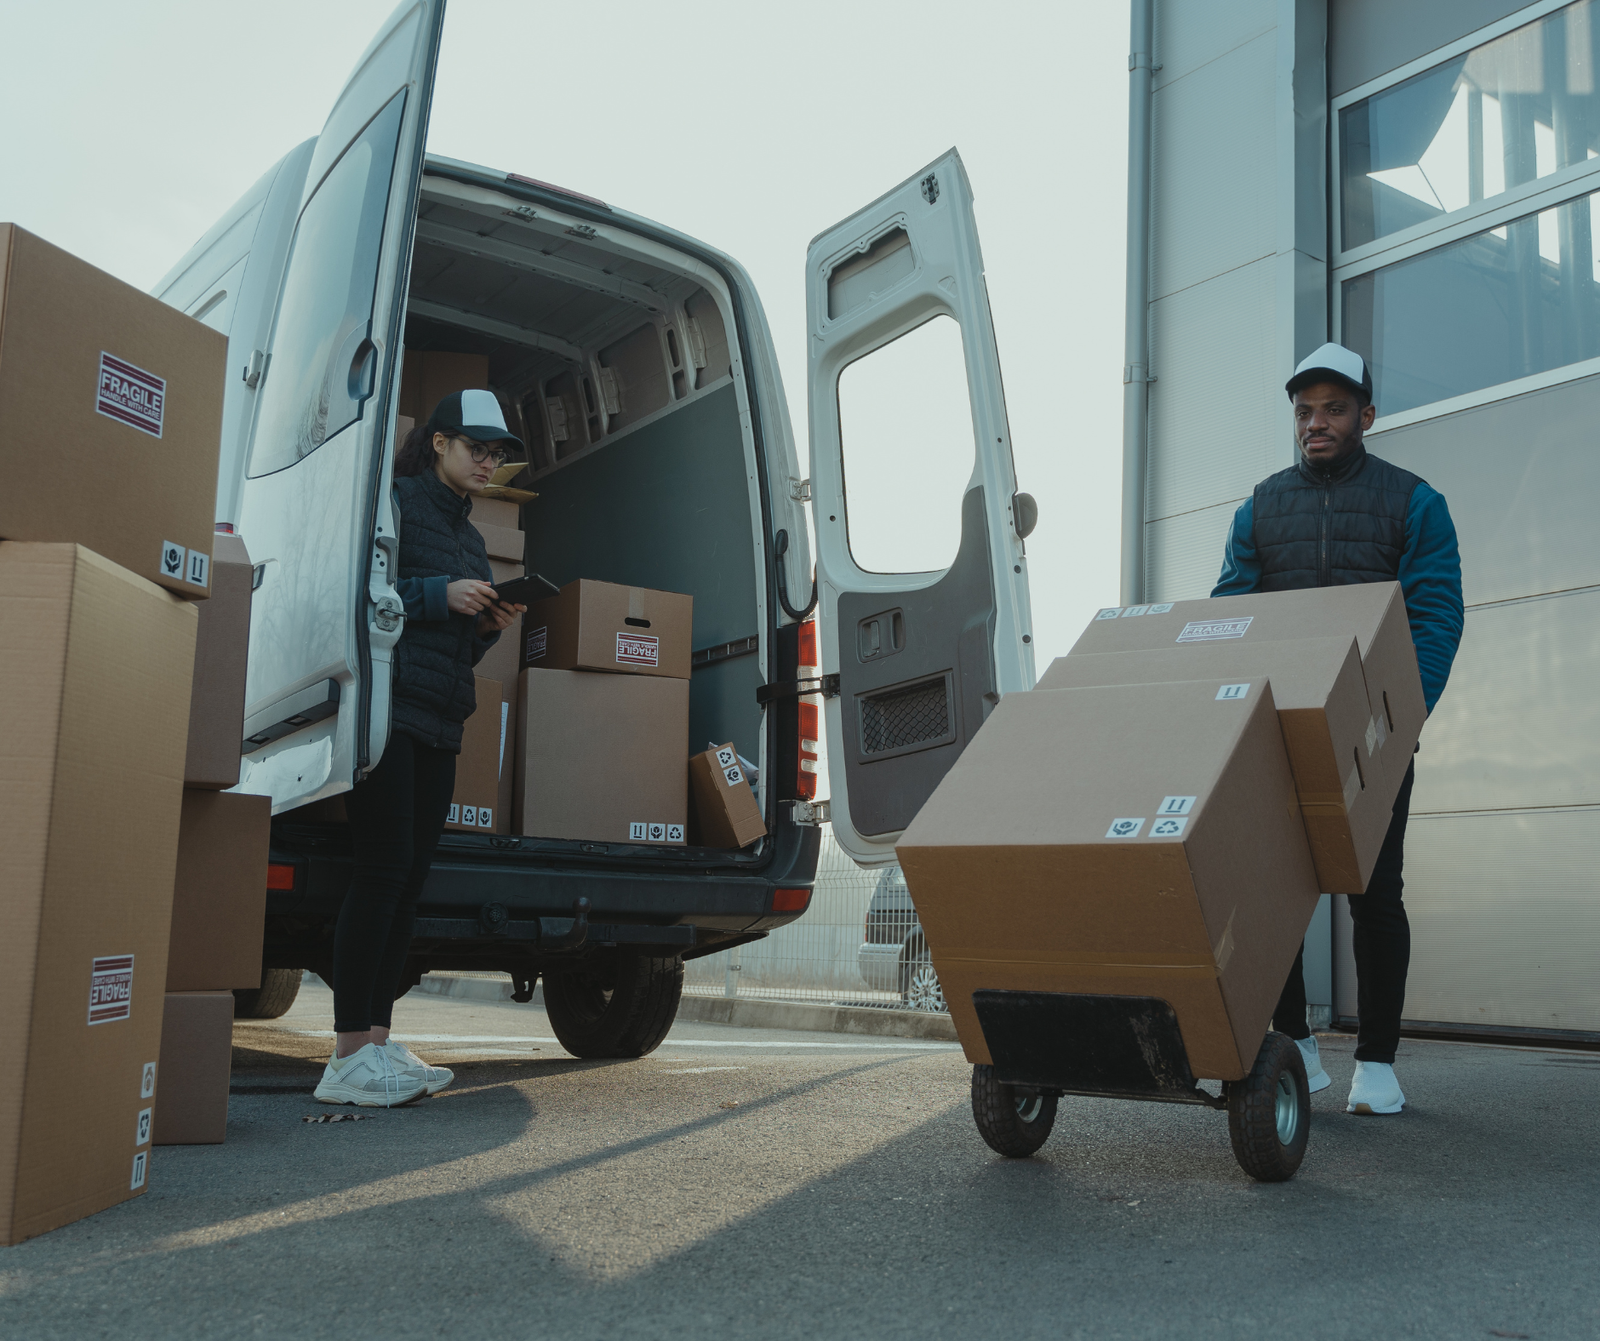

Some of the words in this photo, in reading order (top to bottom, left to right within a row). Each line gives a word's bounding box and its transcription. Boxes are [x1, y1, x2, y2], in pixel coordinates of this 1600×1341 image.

[101, 372, 161, 412] FRAGILE
[101, 388, 127, 405] HANDLE
[127, 399, 143, 412] WITH
[143, 407, 160, 420] CARE
[1184, 623, 1247, 634] FRAGILE
[618, 645, 657, 657] FRAGILE
[92, 982, 131, 1003] FRAGILE
